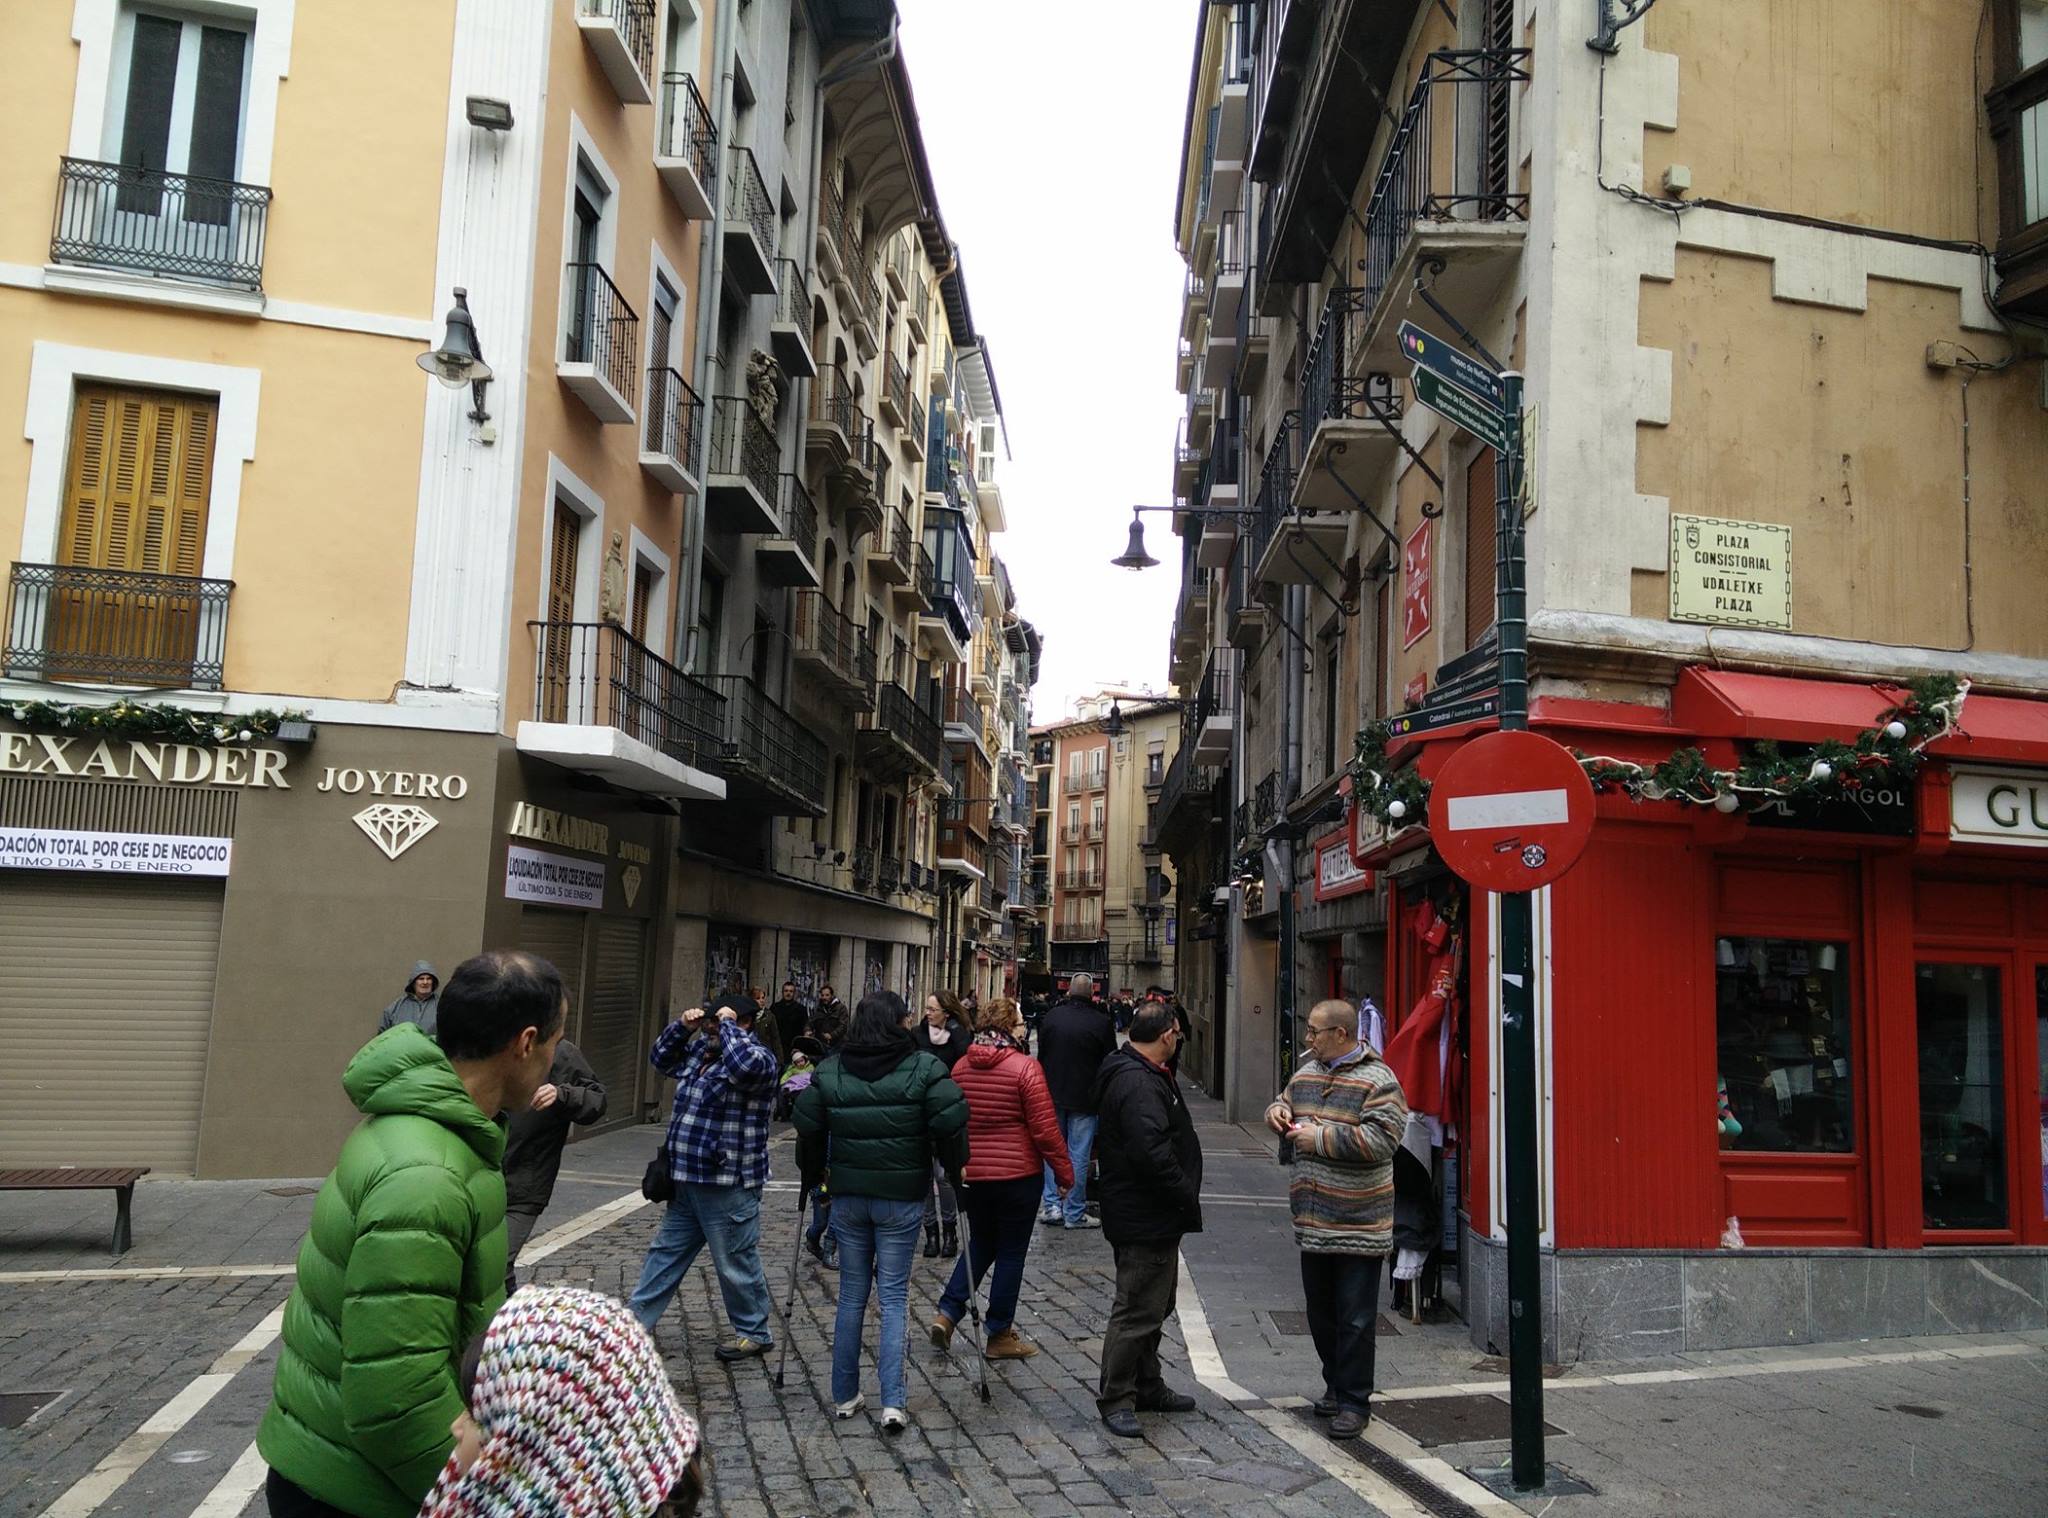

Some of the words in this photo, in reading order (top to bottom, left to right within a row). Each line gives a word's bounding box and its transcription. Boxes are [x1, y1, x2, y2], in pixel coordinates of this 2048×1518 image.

[1438, 384, 1453, 399] Museo
[1716, 534, 1750, 549] PLAZA
[1694, 551, 1772, 571] CONSISTORIAL
[1702, 577, 1763, 595] UDALETXE
[1715, 596, 1753, 613] PLAZA
[1429, 711, 1450, 723] Catedral
[0, 732, 292, 788] EXANDER
[316, 767, 468, 800] JOYERO
[509, 801, 608, 855] ALEXANDER
[50, 839, 88, 856] TOTAL
[92, 840, 119, 857] POR
[121, 842, 149, 859] CESE
[152, 843, 169, 859] DE
[171, 844, 228, 862] NEGOCIO
[57, 858, 86, 868] DIA
[92, 859, 103, 869] 5
[110, 860, 132, 870] DE
[136, 861, 193, 873] ENERO
[509, 856, 542, 880] LIQUIDACIÓN
[543, 863, 558, 882] TOTAL
[558, 865, 568, 884] POR
[544, 885, 556, 896] DIA
[557, 886, 563, 897] 5
[564, 888, 572, 898] DE
[573, 889, 593, 900] ENERO
